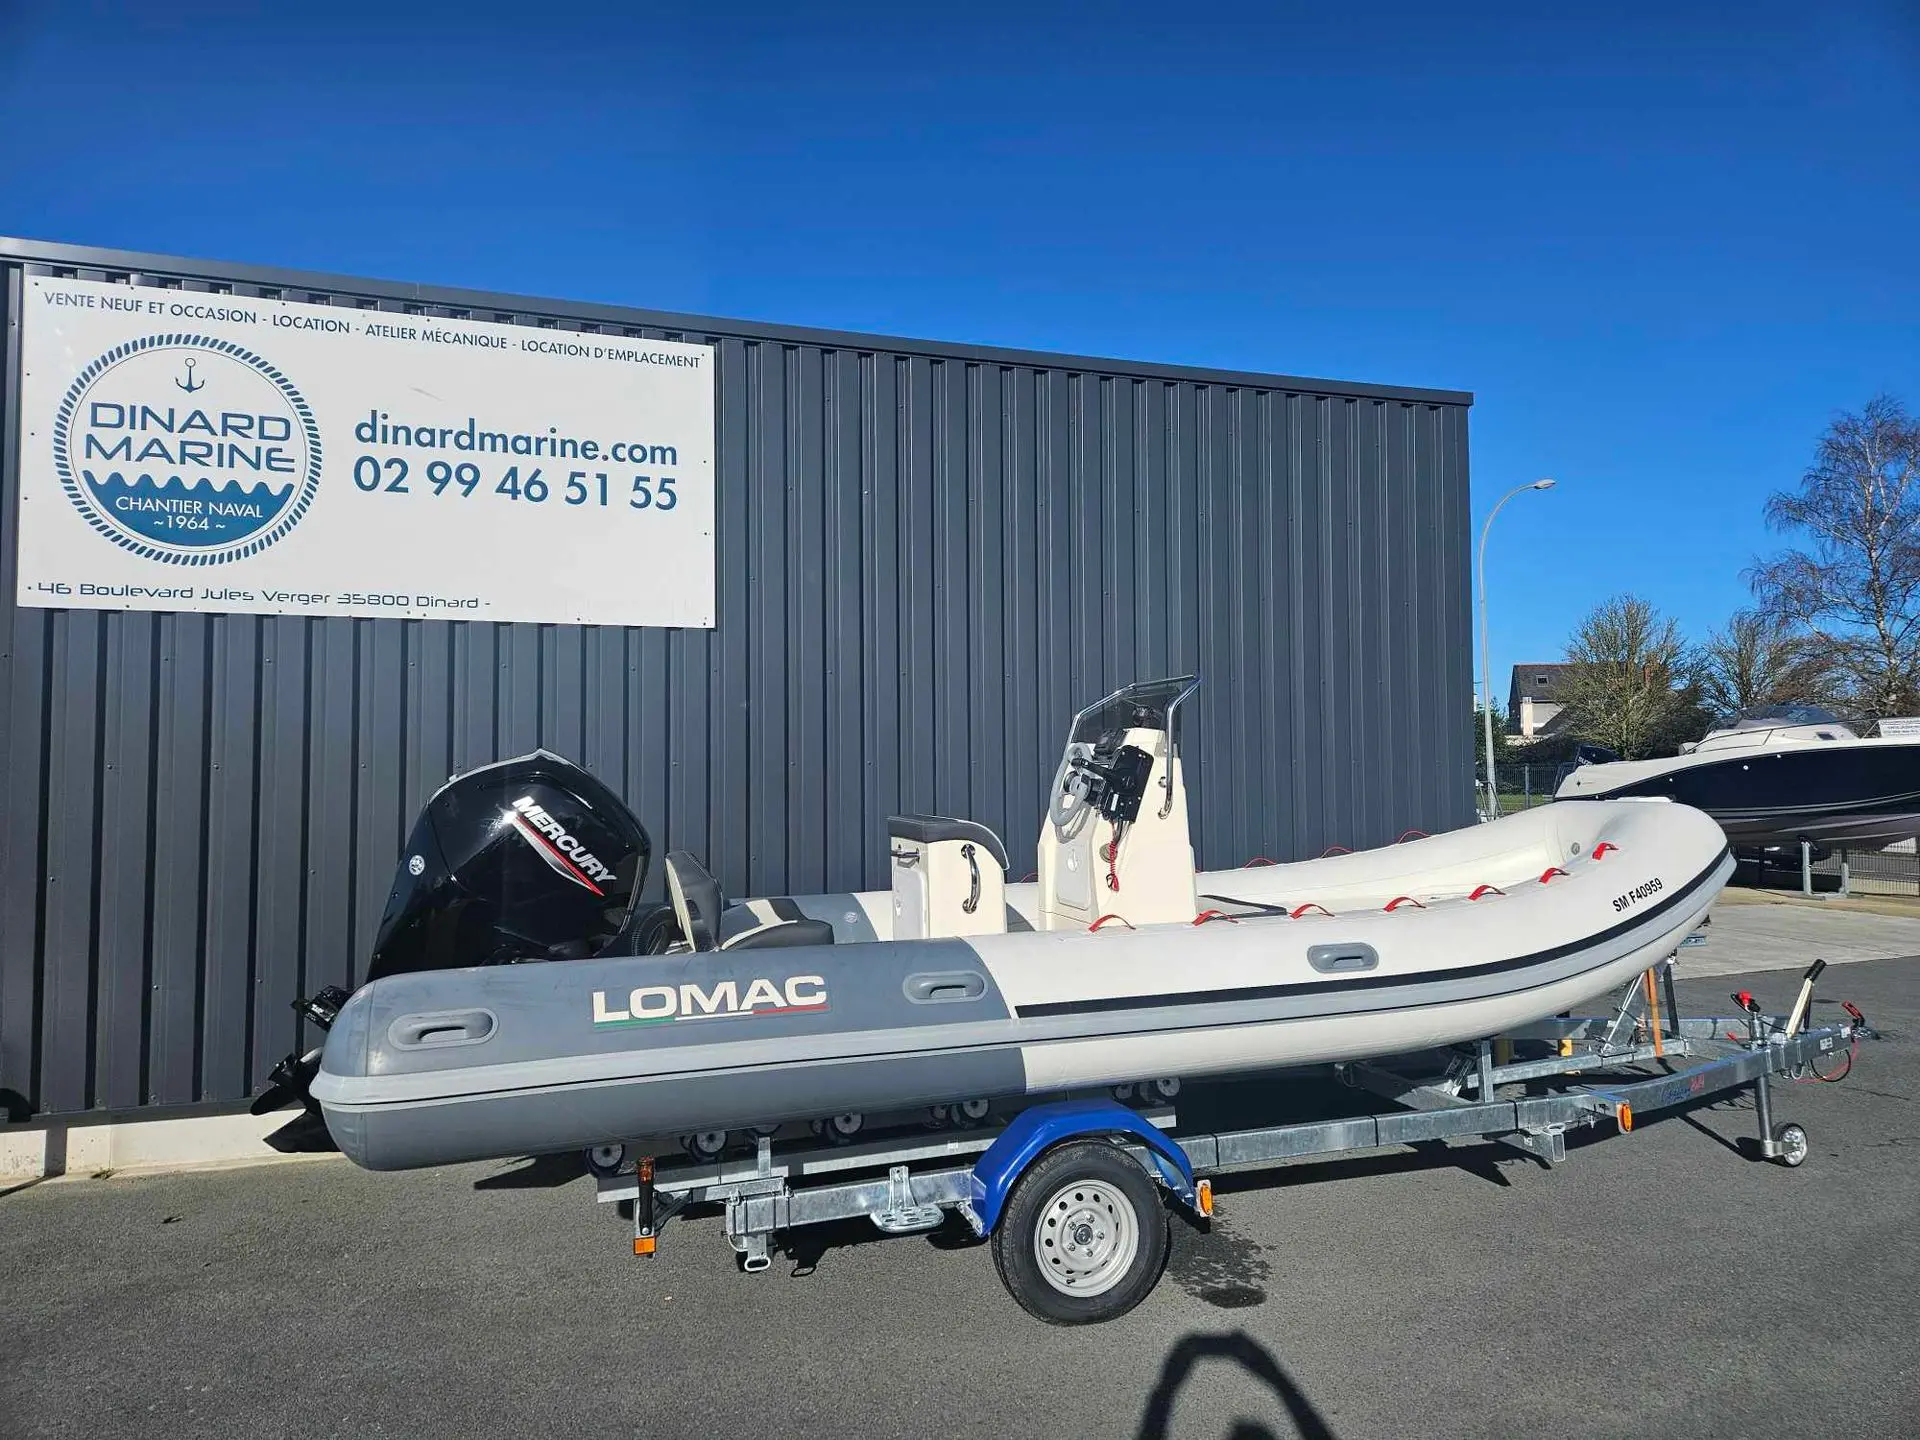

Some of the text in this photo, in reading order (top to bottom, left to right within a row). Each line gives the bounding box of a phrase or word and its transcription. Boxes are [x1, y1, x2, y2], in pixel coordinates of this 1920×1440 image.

[44, 292, 95, 308] VENTE
[100, 297, 143, 313] NEUF
[149, 301, 165, 314] ET
[170, 303, 257, 324] OCCASION
[272, 314, 350, 333] LOCATION
[365, 323, 416, 340] ATELIER
[421, 328, 507, 349] MÉCANIQUE
[521, 339, 590, 358] LOCATION
[594, 347, 700, 368] D'EMPLACEMENT
[91, 402, 291, 442] DINARD
[354, 409, 678, 466] dinardmarine.com
[85, 433, 296, 473] MARINE
[353, 455, 678, 511] 02 99 46 51 55
[115, 496, 263, 519] CHANTIER NAVAL
[38, 582, 72, 595] 46
[79, 583, 194, 599] Boulevard
[200, 587, 254, 601] Jules
[262, 590, 330, 605] Verger
[337, 593, 409, 607] 35800
[416, 595, 479, 609] Dinard
[512, 796, 617, 882] MERCURY
[1612, 877, 1663, 912] SM F40959
[592, 975, 828, 1023] LOMAC
